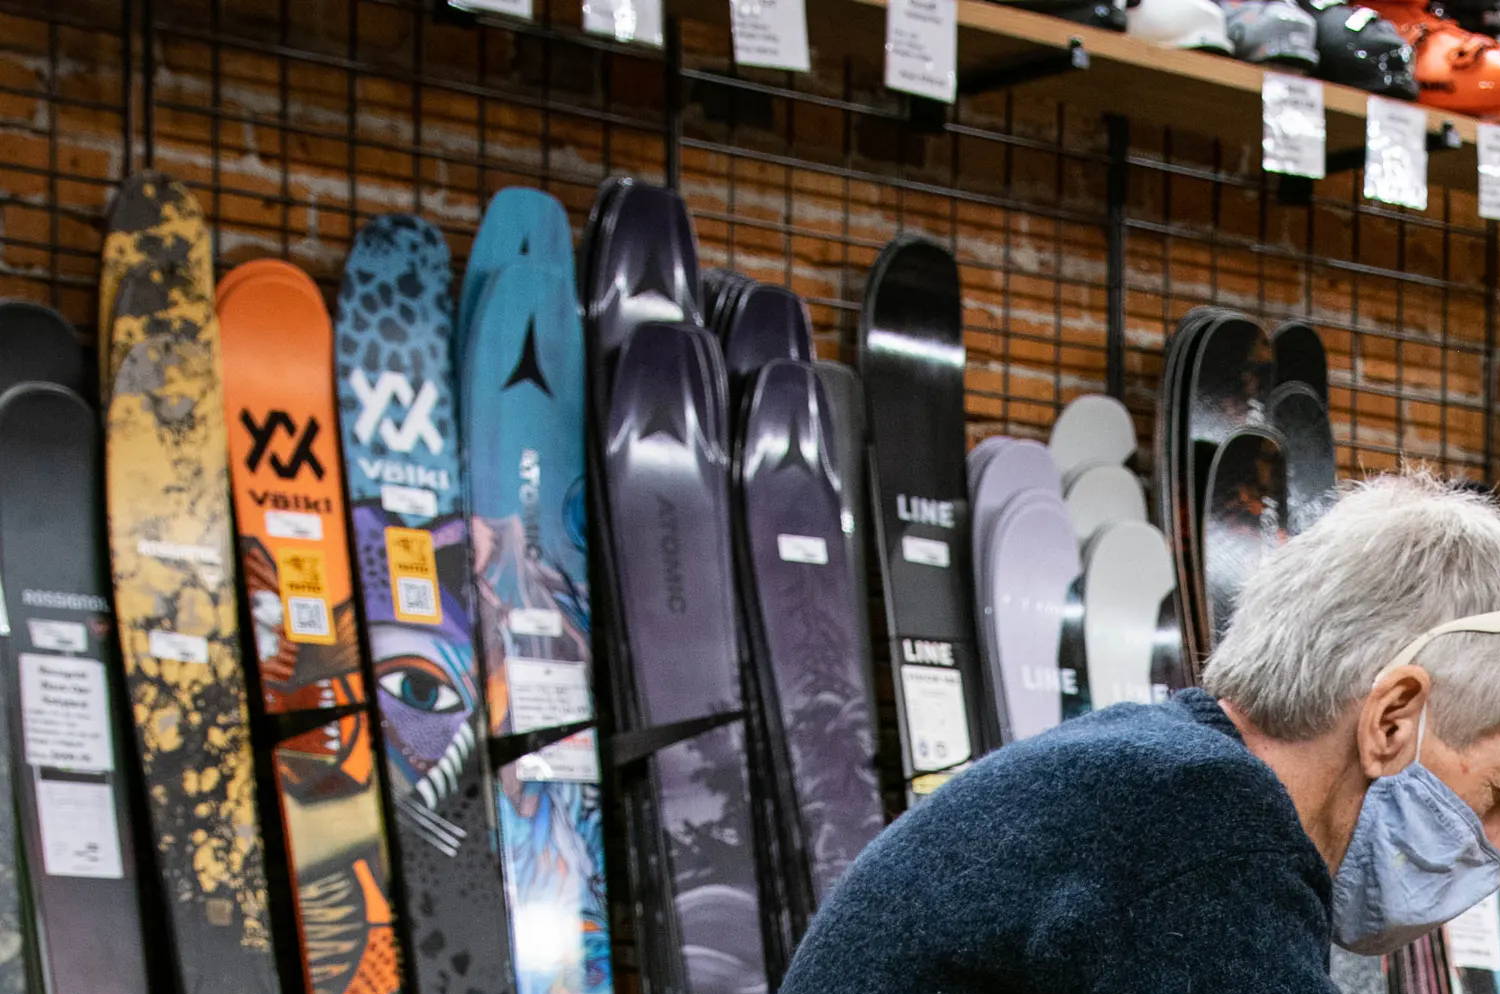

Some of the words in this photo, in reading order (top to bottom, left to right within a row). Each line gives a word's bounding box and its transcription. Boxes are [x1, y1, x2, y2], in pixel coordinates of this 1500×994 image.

[896, 494, 954, 528] LINE
[902, 638, 954, 666] LINE
[1021, 664, 1078, 695] LINE
